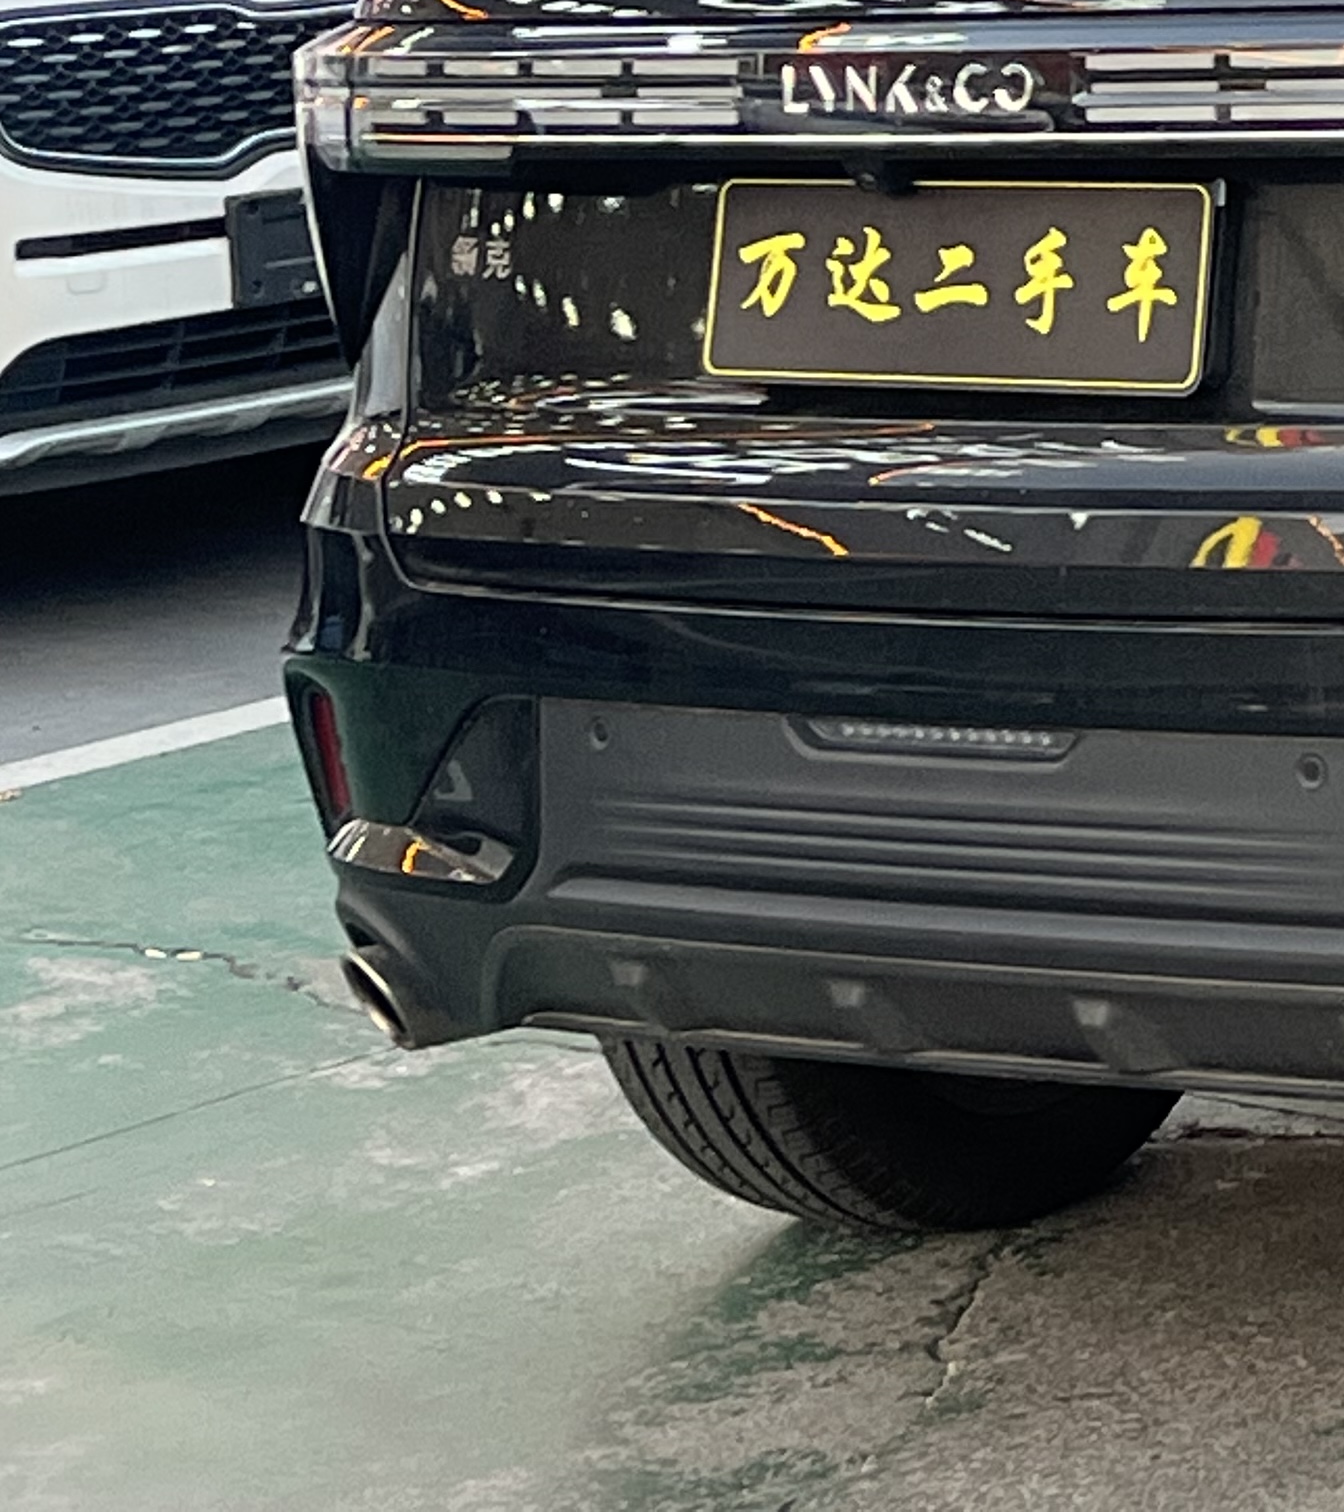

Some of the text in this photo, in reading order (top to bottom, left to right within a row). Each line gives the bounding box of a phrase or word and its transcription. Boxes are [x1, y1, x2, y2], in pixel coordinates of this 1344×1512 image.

[736, 225, 1180, 344] 万达二手车
